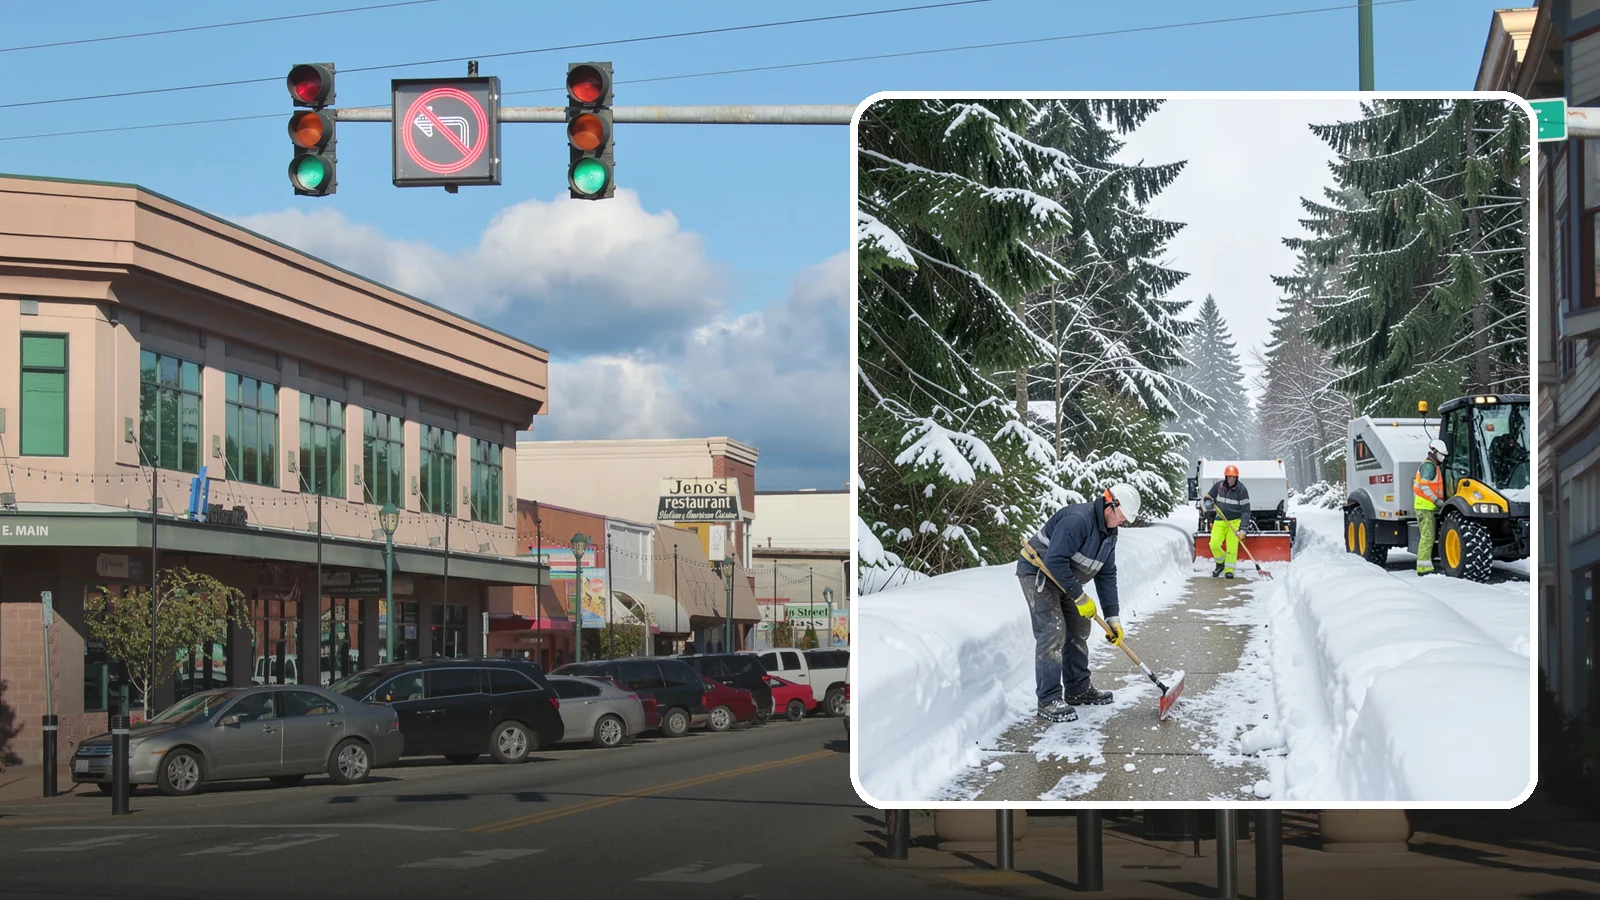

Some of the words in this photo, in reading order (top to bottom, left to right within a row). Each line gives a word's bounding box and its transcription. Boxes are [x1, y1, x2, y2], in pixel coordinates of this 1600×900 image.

[670, 480, 727, 494] Jeno's
[665, 496, 731, 509] restaurant
[658, 509, 681, 519] Italian
[685, 509, 714, 519] American
[715, 509, 737, 519] Cuisine
[2, 525, 13, 536] E.
[15, 525, 49, 536] MAIN
[797, 607, 829, 617] Street
